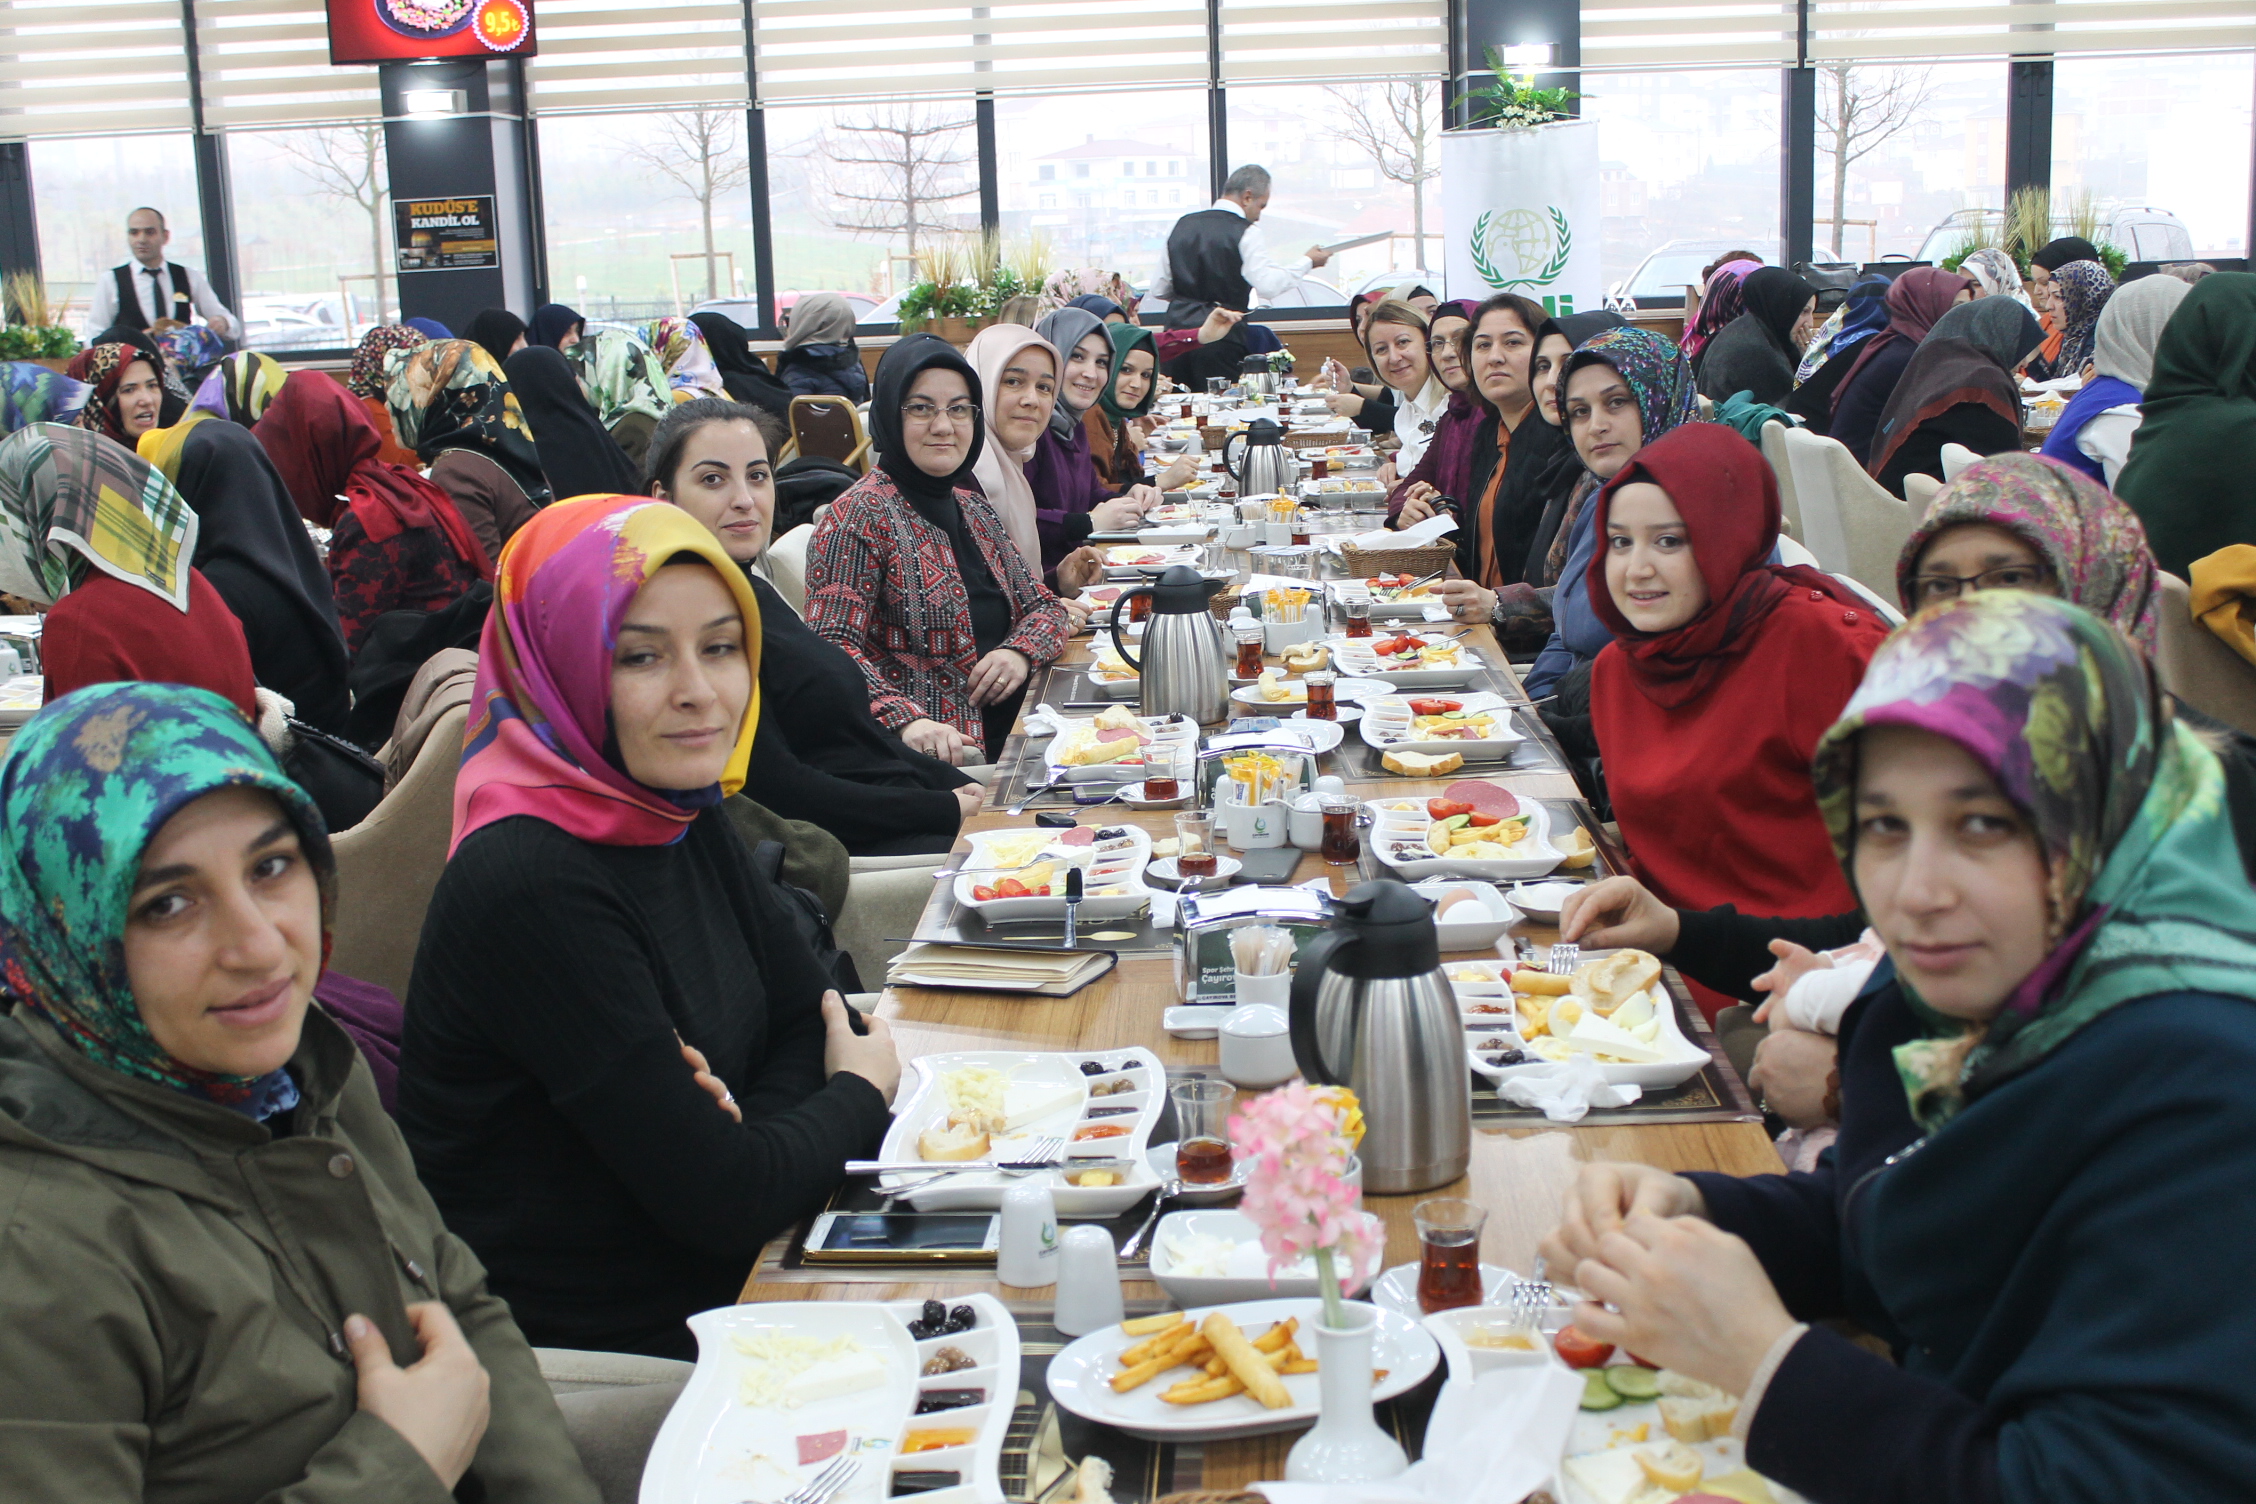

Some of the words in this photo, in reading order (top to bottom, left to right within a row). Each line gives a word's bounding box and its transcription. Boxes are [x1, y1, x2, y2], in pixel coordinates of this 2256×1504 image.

[410, 199, 478, 215] KUDÜS'E
[411, 214, 461, 228] KANDİL
[461, 214, 479, 226] OL
[1219, 966, 1235, 974] Şehr
[1201, 974, 1235, 984] Çayıro
